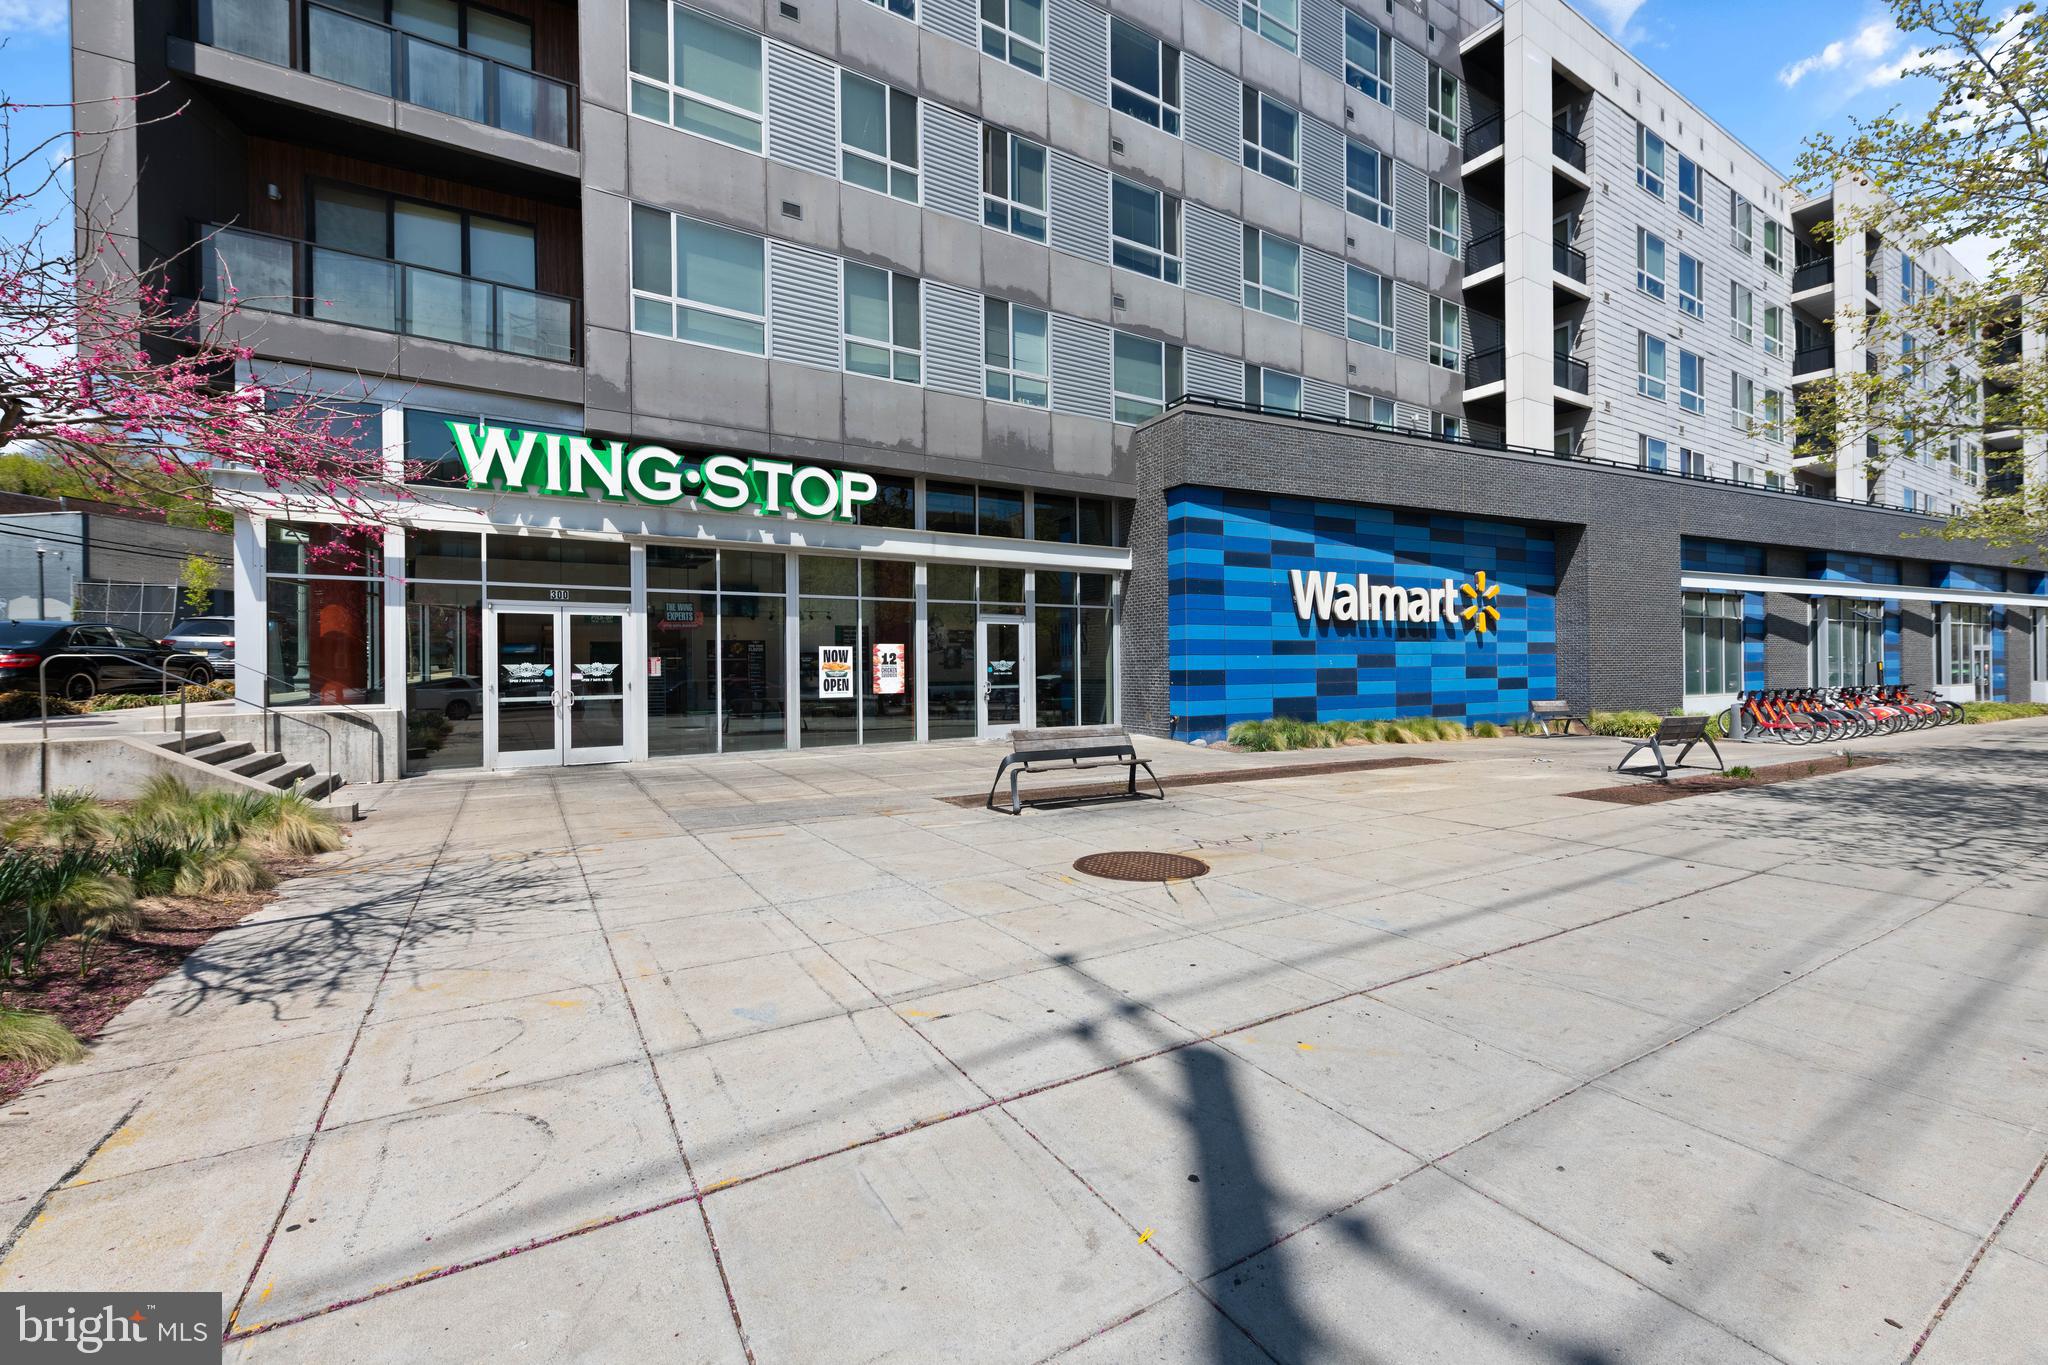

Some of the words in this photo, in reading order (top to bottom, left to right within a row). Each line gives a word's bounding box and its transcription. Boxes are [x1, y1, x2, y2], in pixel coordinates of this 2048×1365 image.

[551, 590, 568, 599] 300
[1289, 569, 1459, 623] Walmart
[666, 611, 693, 621] EXPERTS
[823, 649, 849, 663] NOW
[881, 652, 897, 665] 12
[823, 678, 849, 692] OPEN
